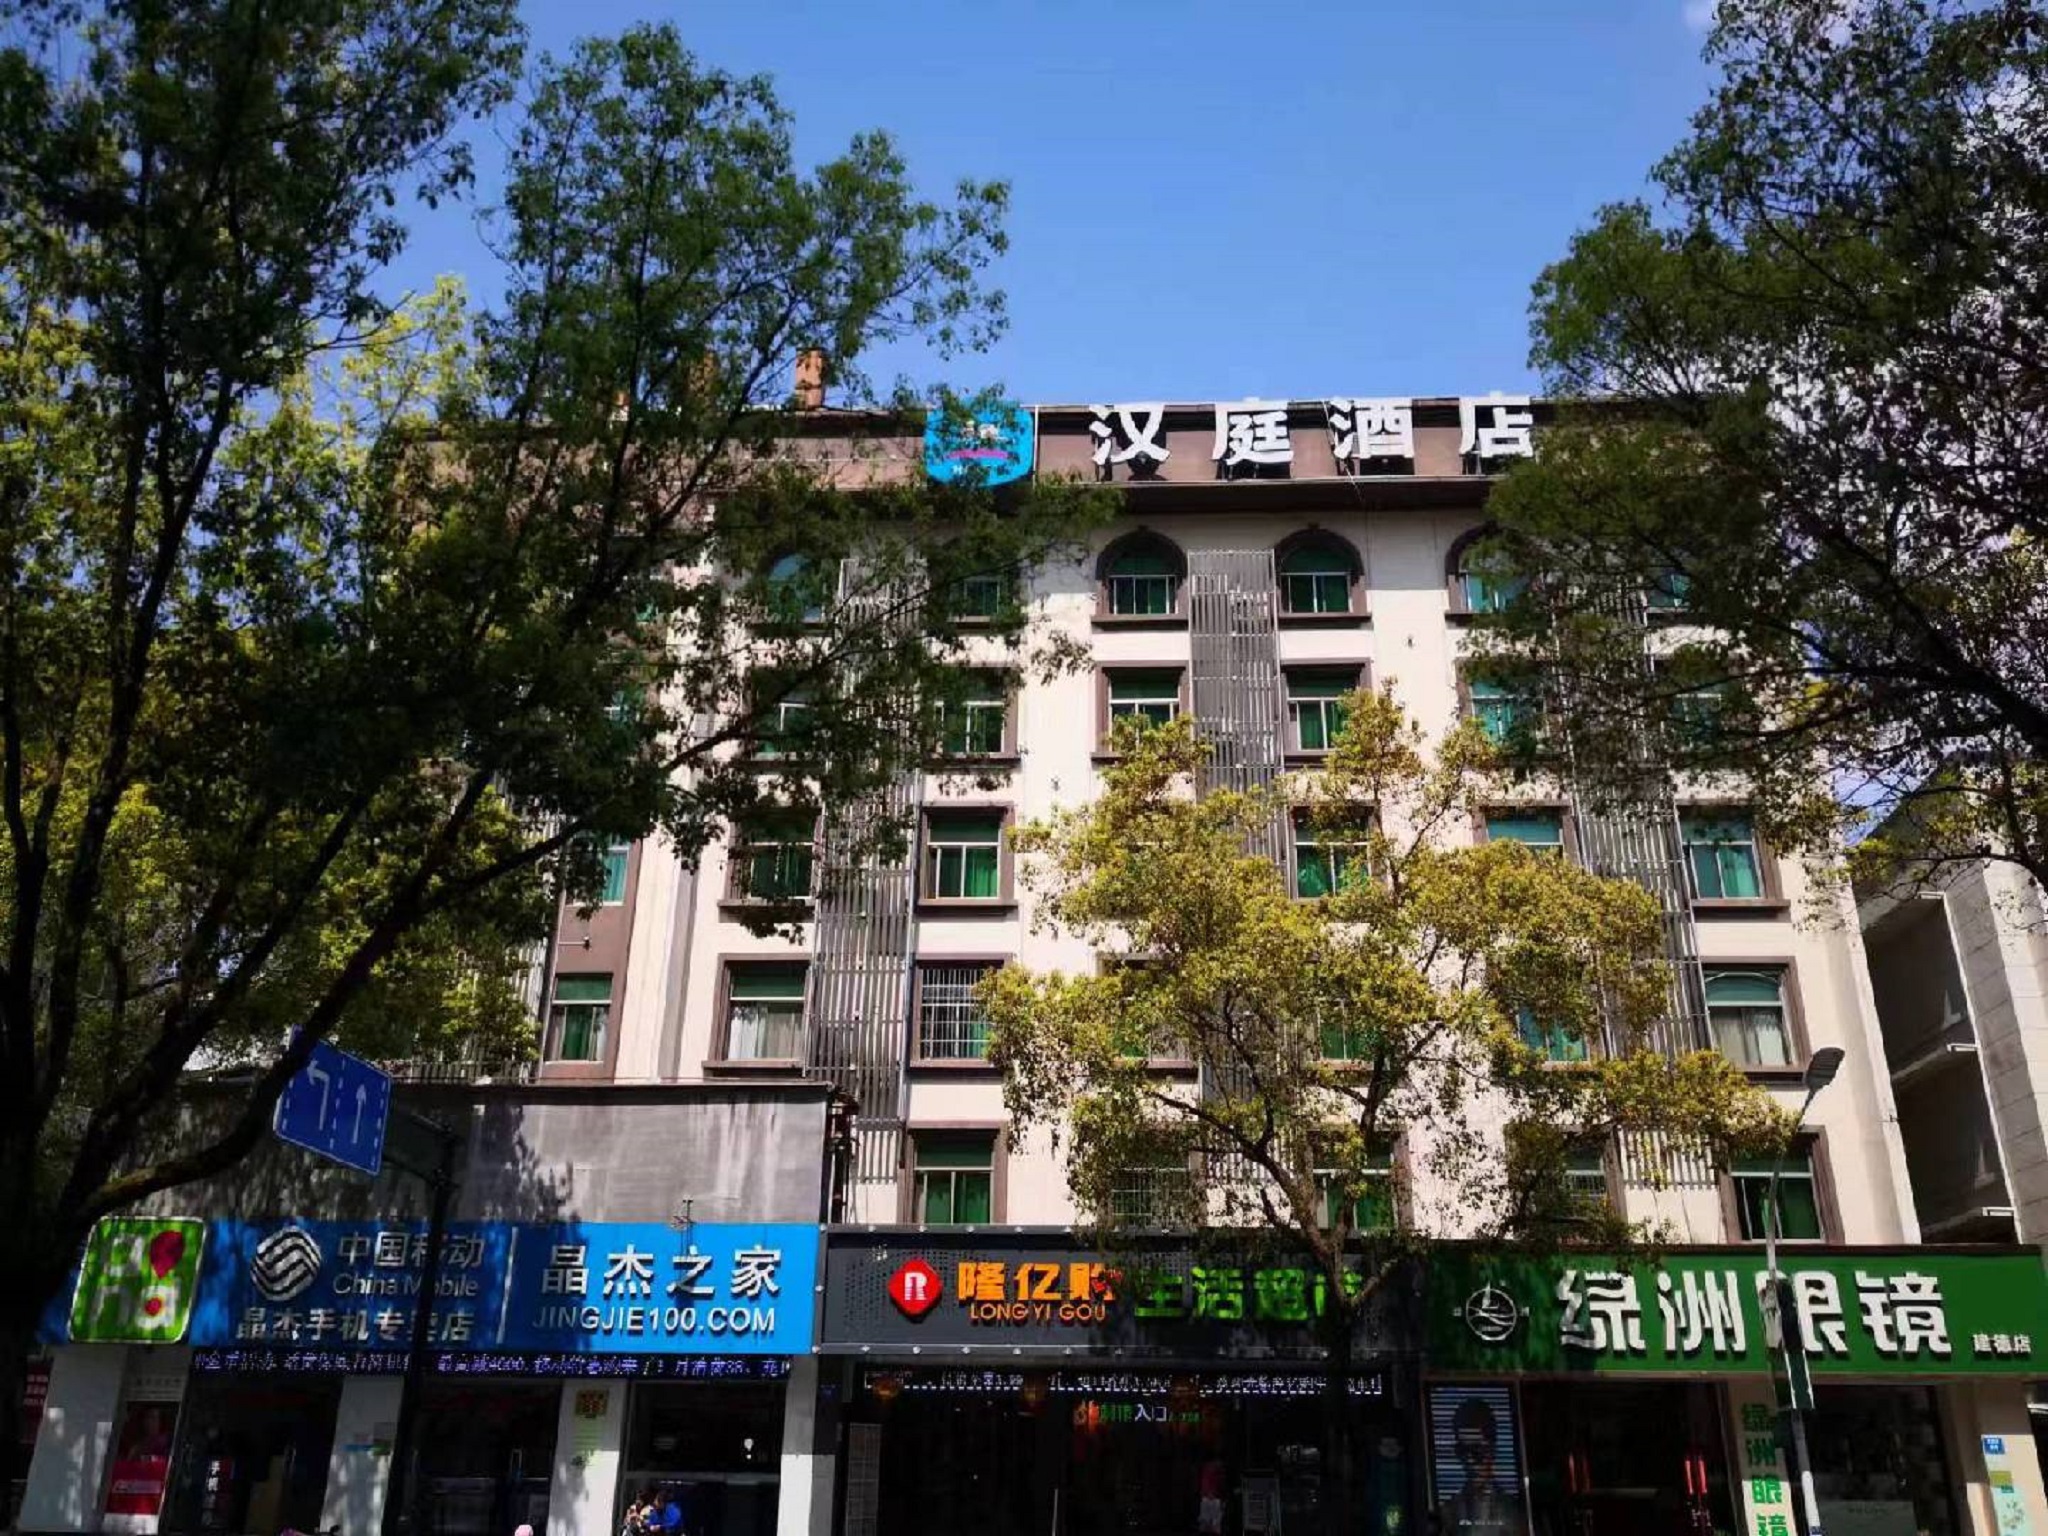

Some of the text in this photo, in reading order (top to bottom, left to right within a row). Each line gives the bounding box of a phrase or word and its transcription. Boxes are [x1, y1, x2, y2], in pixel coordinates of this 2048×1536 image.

[1089, 393, 1534, 466] 汉庭酒店
[333, 1272, 397, 1296] China
[541, 1244, 781, 1297] 晶杰之家
[533, 1306, 776, 1333] JINGJIE100.COM
[970, 1303, 1106, 1322] LONG YI GOU
[1557, 1270, 1953, 1353] 绿洲眼镜
